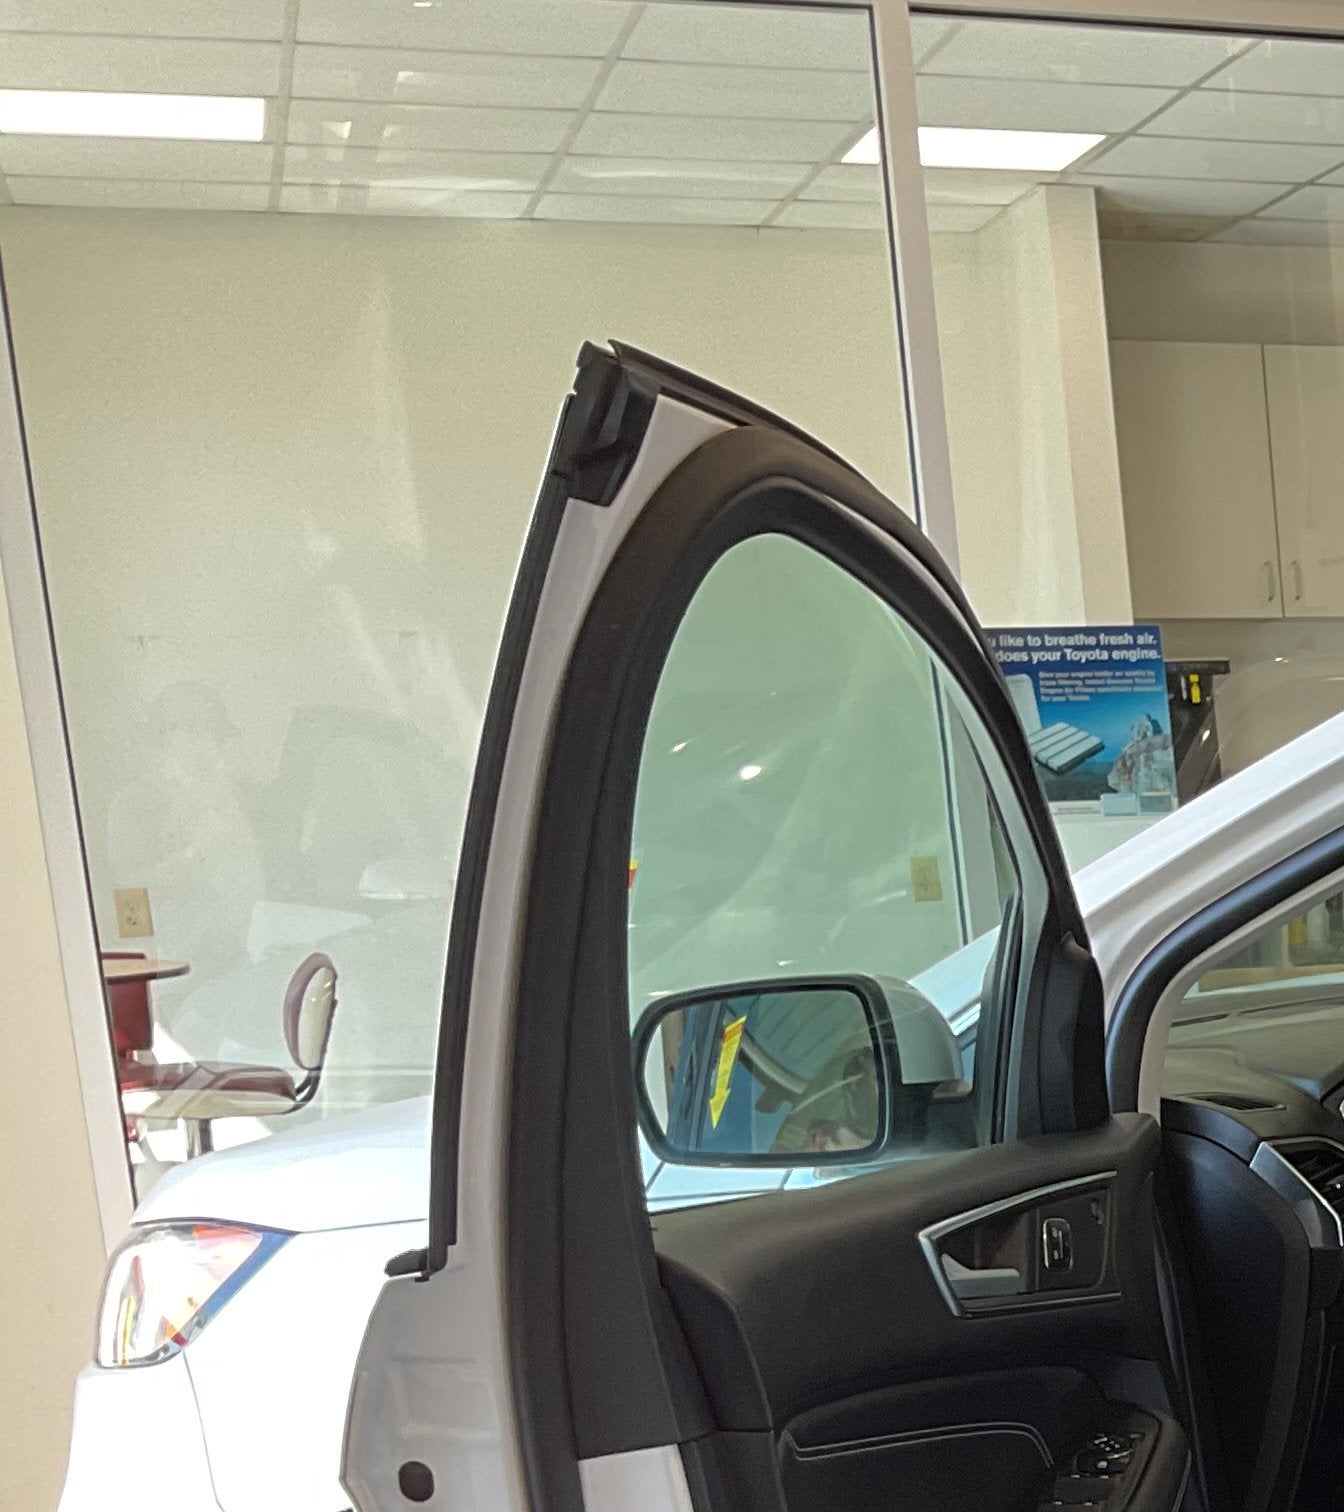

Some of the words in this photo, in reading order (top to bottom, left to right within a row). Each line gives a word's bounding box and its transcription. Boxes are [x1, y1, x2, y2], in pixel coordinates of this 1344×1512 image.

[999, 634, 1024, 647] like
[1027, 634, 1041, 647] to
[1044, 633, 1097, 646] breathe
[1098, 632, 1134, 646] fresh
[1137, 632, 1157, 645] air.
[995, 650, 1029, 663] does
[1032, 650, 1062, 664] your
[1065, 648, 1109, 664] Toyota
[1112, 647, 1161, 663] engine.
